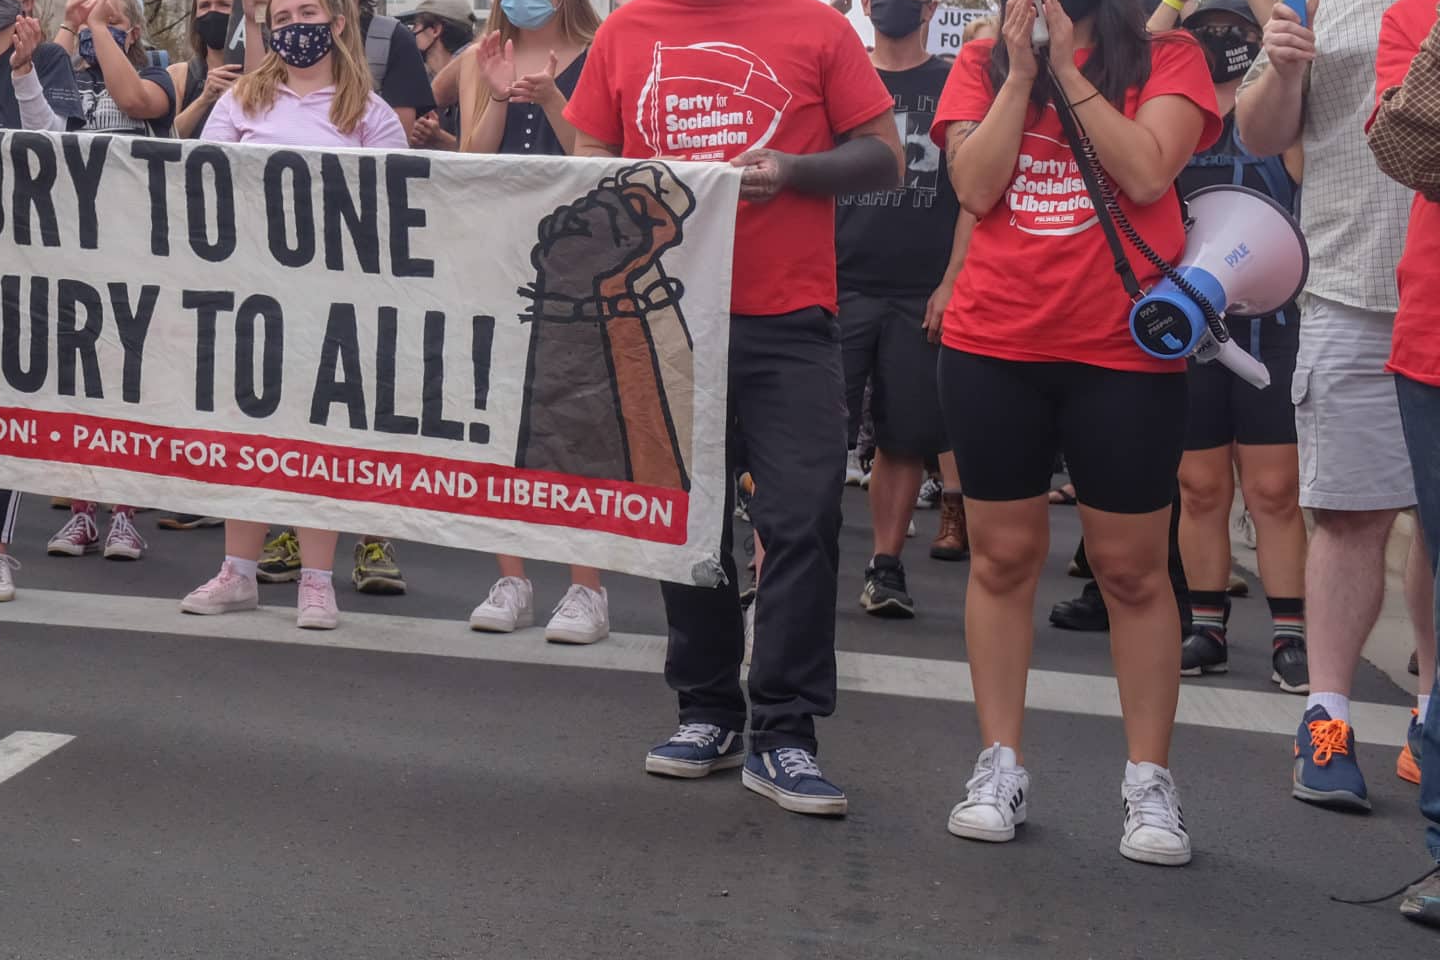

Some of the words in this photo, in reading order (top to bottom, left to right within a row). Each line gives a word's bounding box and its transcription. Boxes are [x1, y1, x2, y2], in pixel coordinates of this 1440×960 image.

[665, 94, 713, 112] Party
[716, 93, 728, 108] for
[665, 111, 743, 132] Socialism
[746, 110, 753, 125] &
[666, 129, 747, 150] Liberation
[1019, 154, 1066, 178] Party
[1069, 158, 1080, 174] fo
[1013, 174, 1088, 195] Socialis
[130, 140, 237, 263] TO
[264, 151, 435, 278] ONE
[1223, 242, 1251, 268] PYLE
[182, 289, 284, 419] TO
[310, 302, 495, 444] ALL!
[73, 424, 163, 459] PARTY
[169, 439, 227, 468] FOR
[237, 446, 402, 489] SOCIALISM
[410, 467, 478, 499] AND
[487, 476, 674, 528] LIBERATION
